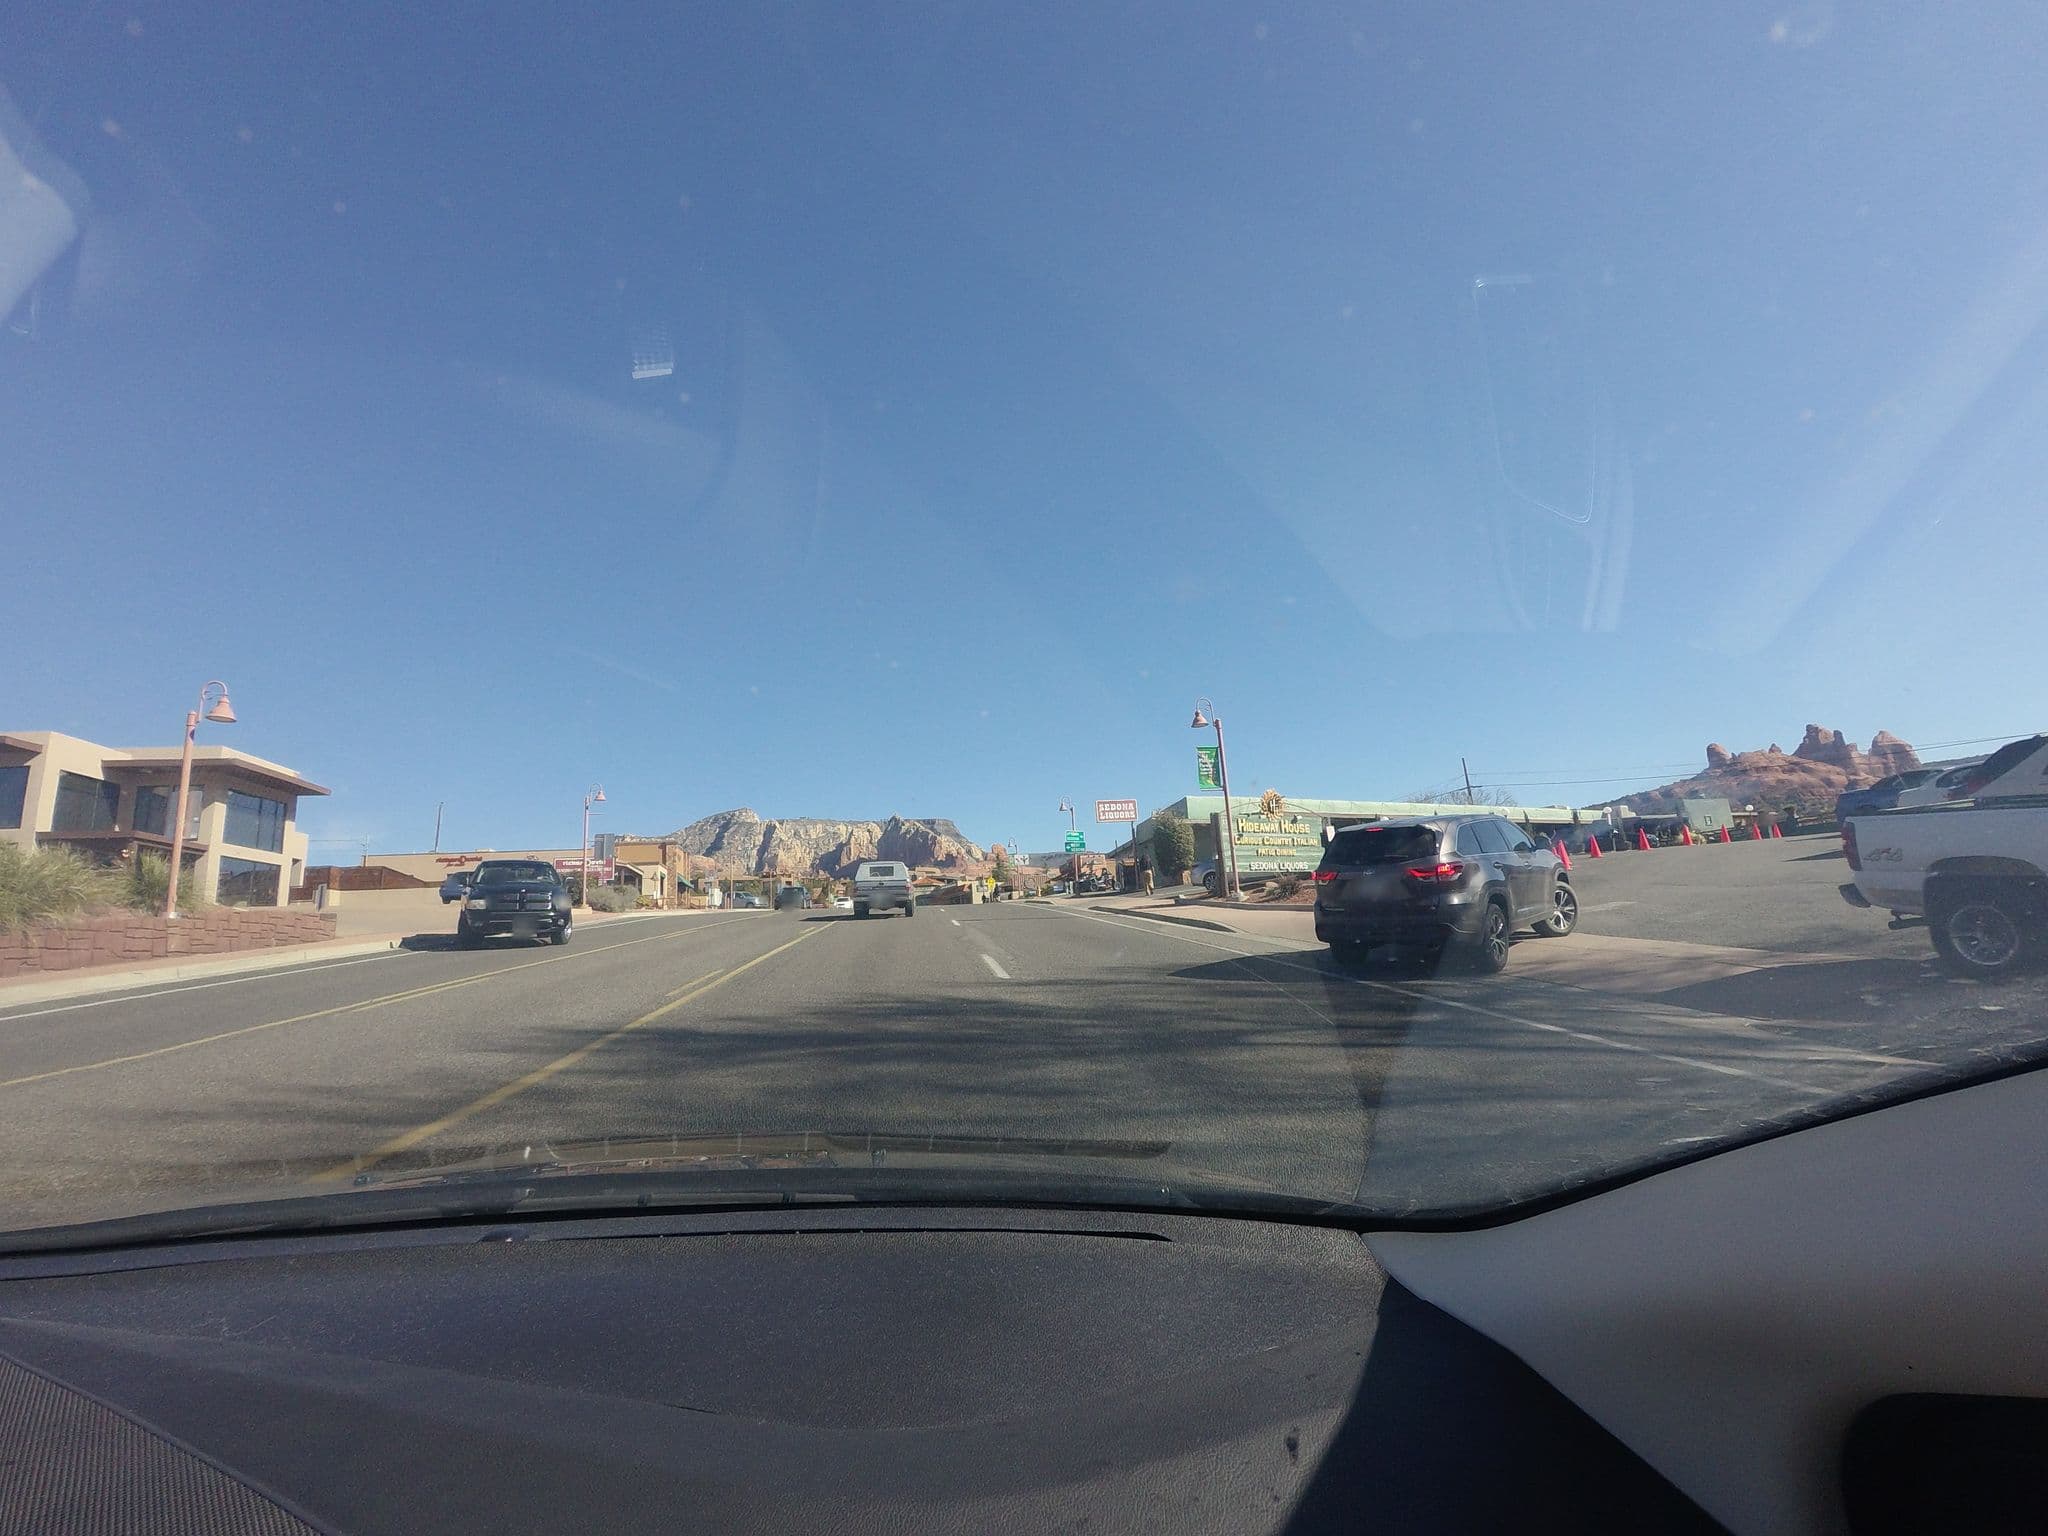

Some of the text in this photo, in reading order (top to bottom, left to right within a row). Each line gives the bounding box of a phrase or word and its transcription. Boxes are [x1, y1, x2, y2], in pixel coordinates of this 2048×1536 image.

[1099, 803, 1134, 812] SEDONA
[1100, 811, 1136, 820] LIQUORS
[1237, 817, 1311, 834] HIDEAWAY HOUSE
[1263, 836, 1292, 845] COUNTRY
[1292, 837, 1318, 846] ITALIAN
[1249, 861, 1309, 872] SEDONA LIQUORS
